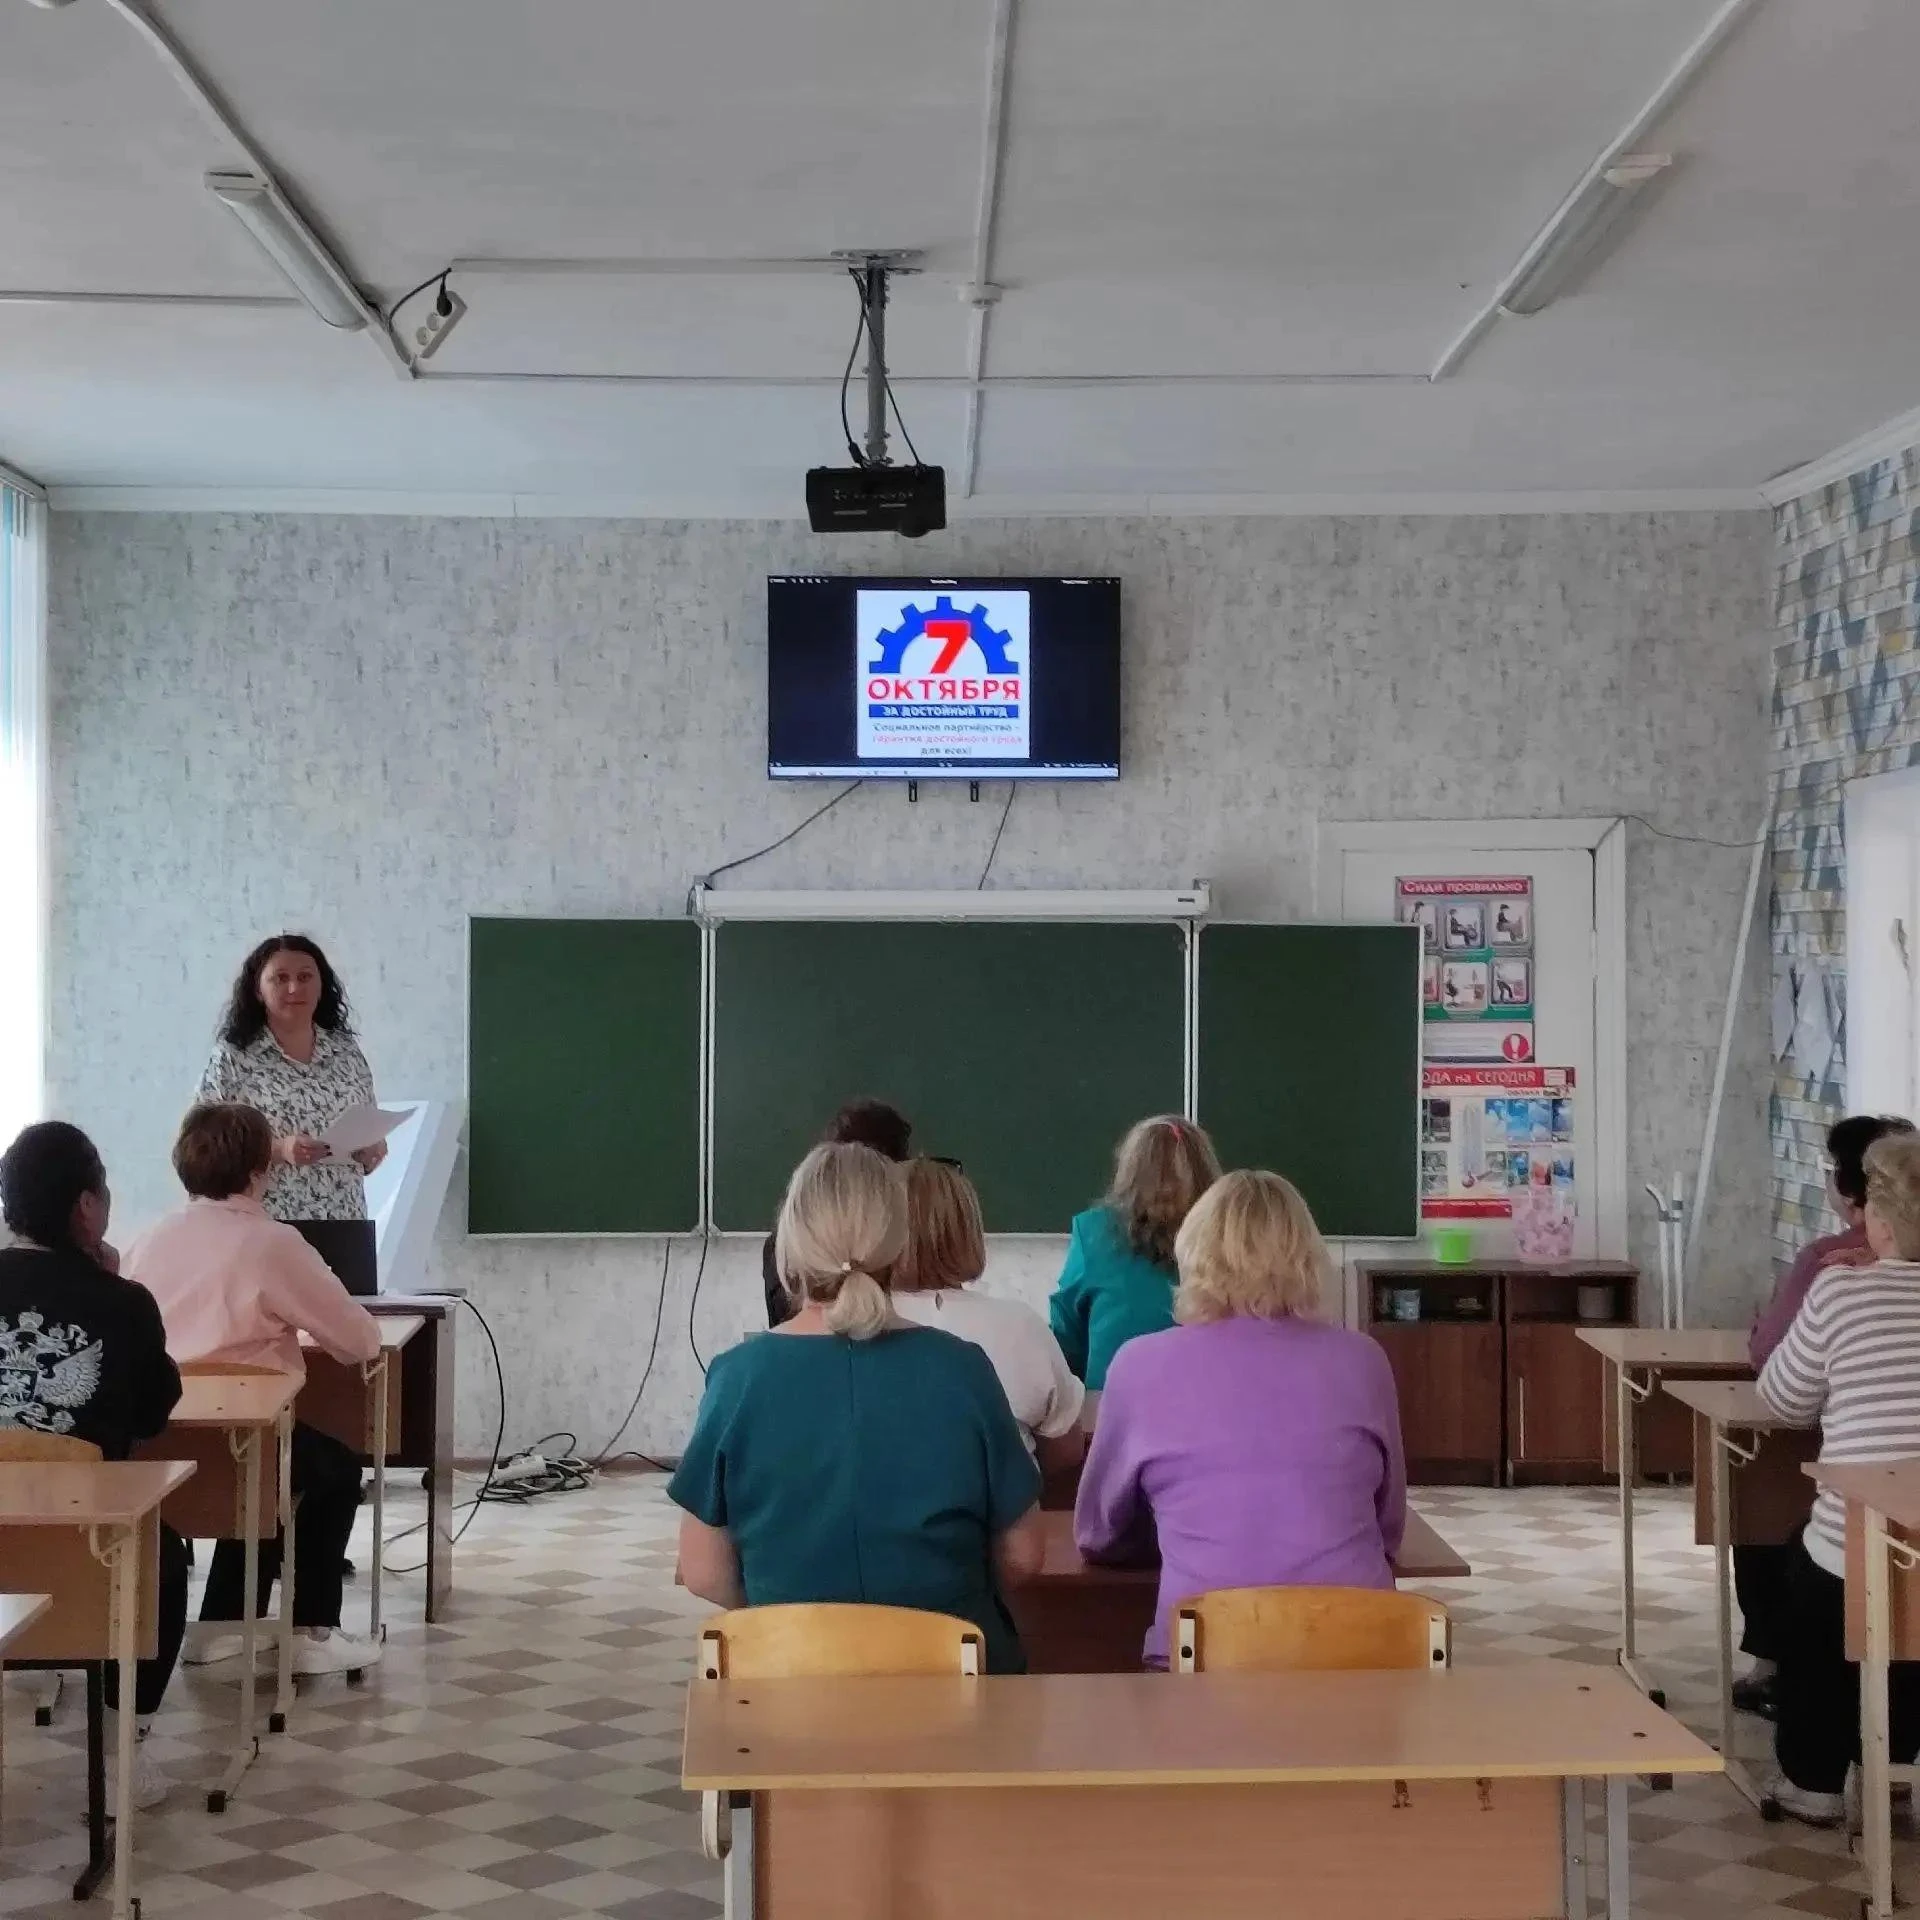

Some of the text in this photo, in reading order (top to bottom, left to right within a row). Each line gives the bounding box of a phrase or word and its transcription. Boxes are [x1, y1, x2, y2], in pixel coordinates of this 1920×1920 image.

[925, 620, 971, 674] 7
[868, 678, 1020, 700] ОКТЯБРЯ
[883, 705, 1008, 718] ЗА ДОСТОЙНЫЙ ТРУД
[1404, 881, 1524, 893] Сиди правильно
[1455, 1073, 1471, 1083] на
[1476, 1070, 1536, 1084] СЕГОДНЯ
